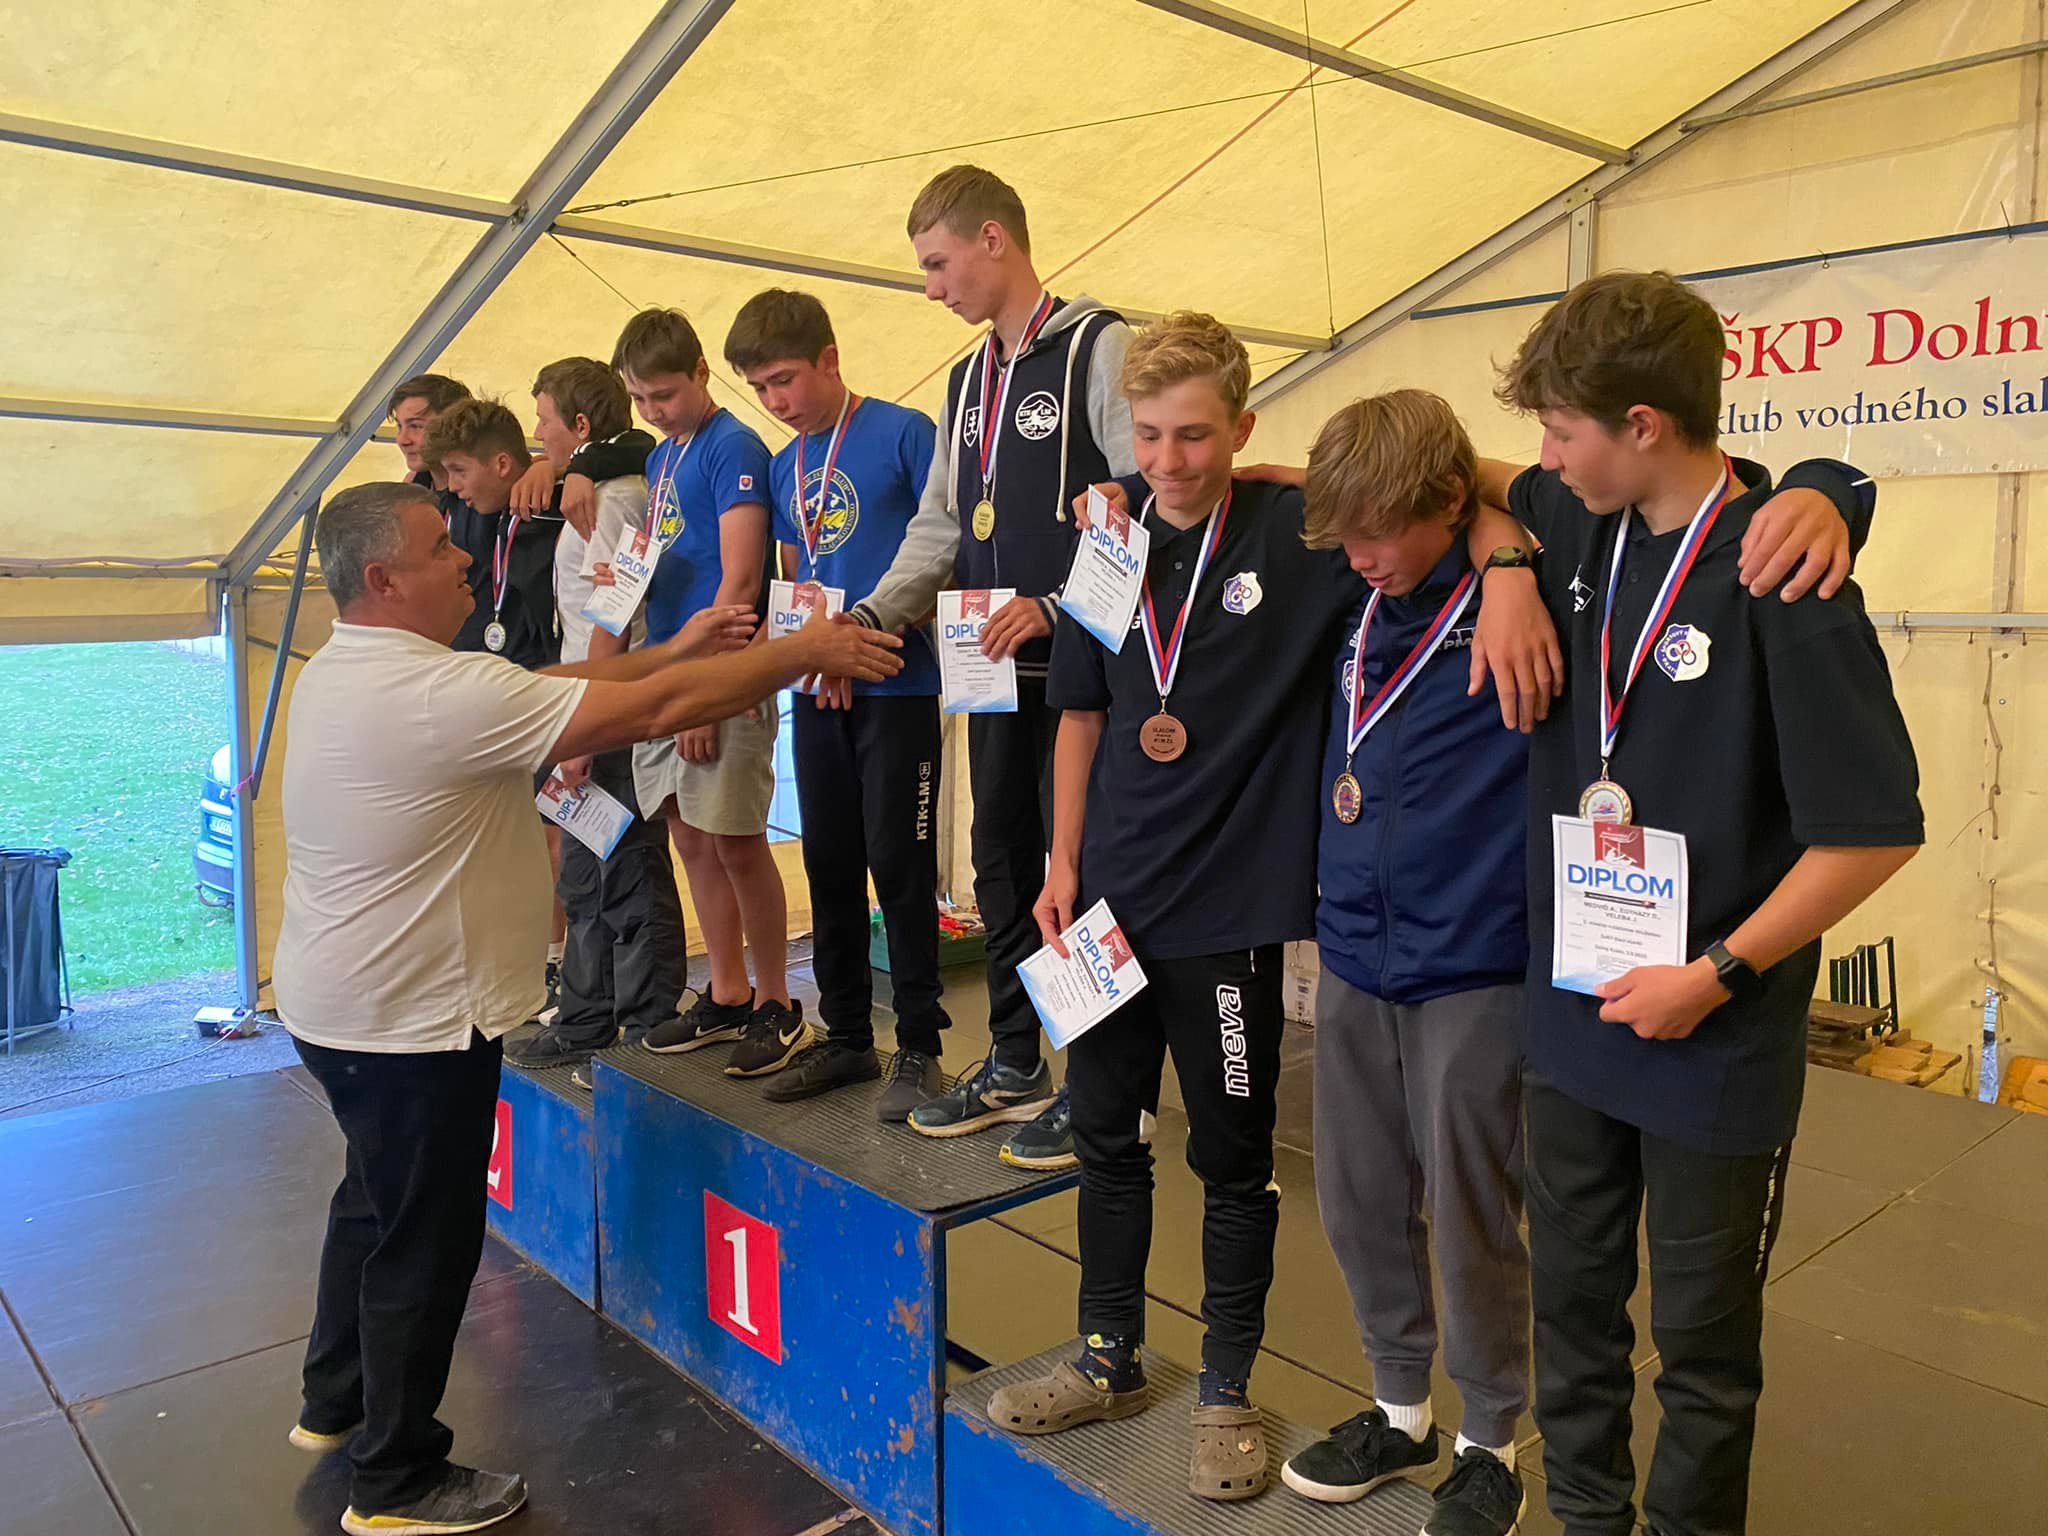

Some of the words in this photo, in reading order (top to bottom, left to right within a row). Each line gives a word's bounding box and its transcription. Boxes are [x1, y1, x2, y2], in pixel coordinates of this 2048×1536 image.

[1866, 296, 2048, 367] Doln
[1796, 387, 1967, 428] vodného
[616, 551, 649, 577] DIPLOM
[1089, 523, 1139, 575] DIPLOM
[945, 622, 987, 639] DIPL
[916, 781, 930, 841] KTK-LM
[1567, 863, 1673, 899] DIPLOM
[1077, 926, 1121, 1000] DIPLOM
[1216, 984, 1250, 1098] meva
[723, 1227, 758, 1336] 1
